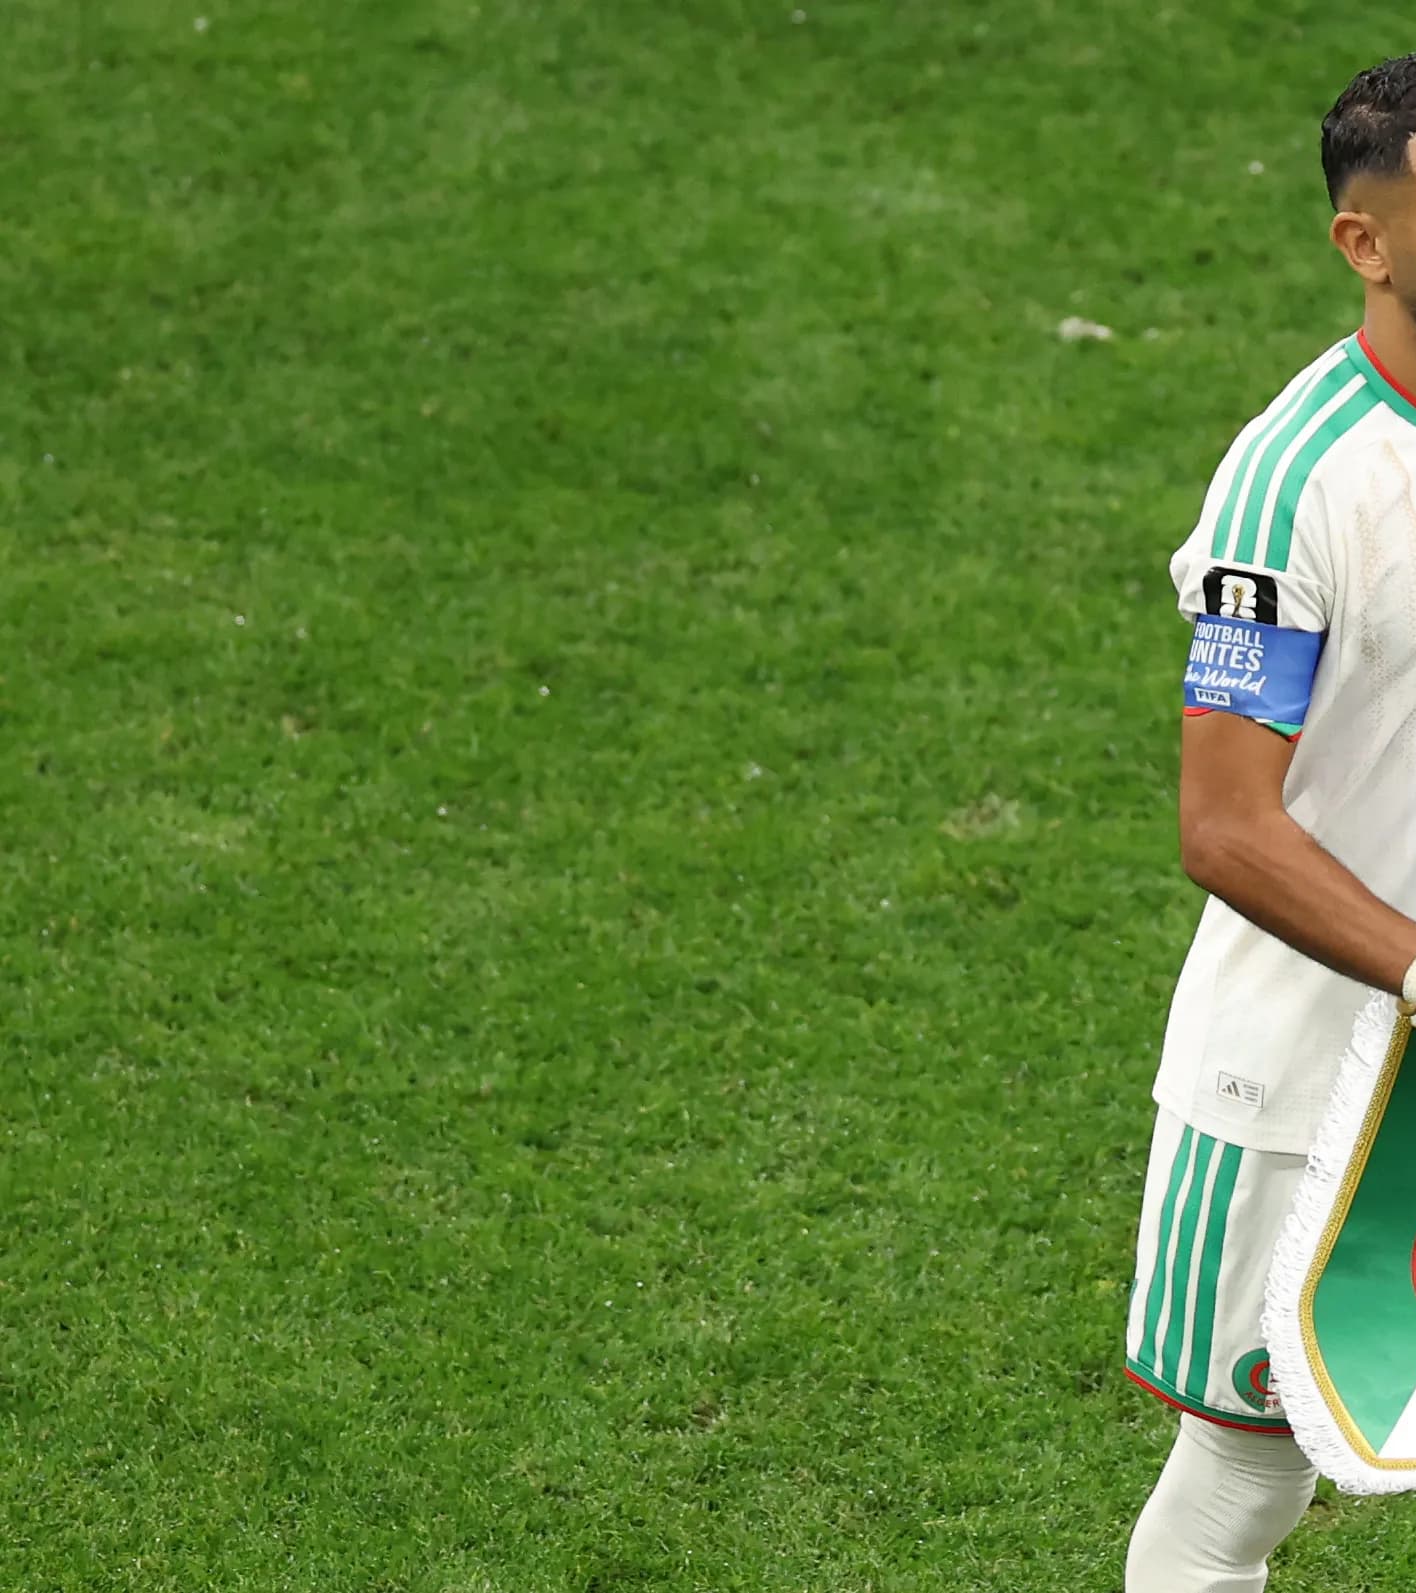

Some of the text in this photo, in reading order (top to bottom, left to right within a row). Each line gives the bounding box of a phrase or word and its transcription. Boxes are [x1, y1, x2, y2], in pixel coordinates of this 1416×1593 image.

[1195, 622, 1264, 648] FOOTBALL
[1189, 639, 1264, 672] UNITES
[1184, 664, 1267, 695] he World
[1197, 690, 1228, 703] FIFA
[1244, 1391, 1280, 1408] ALGER
